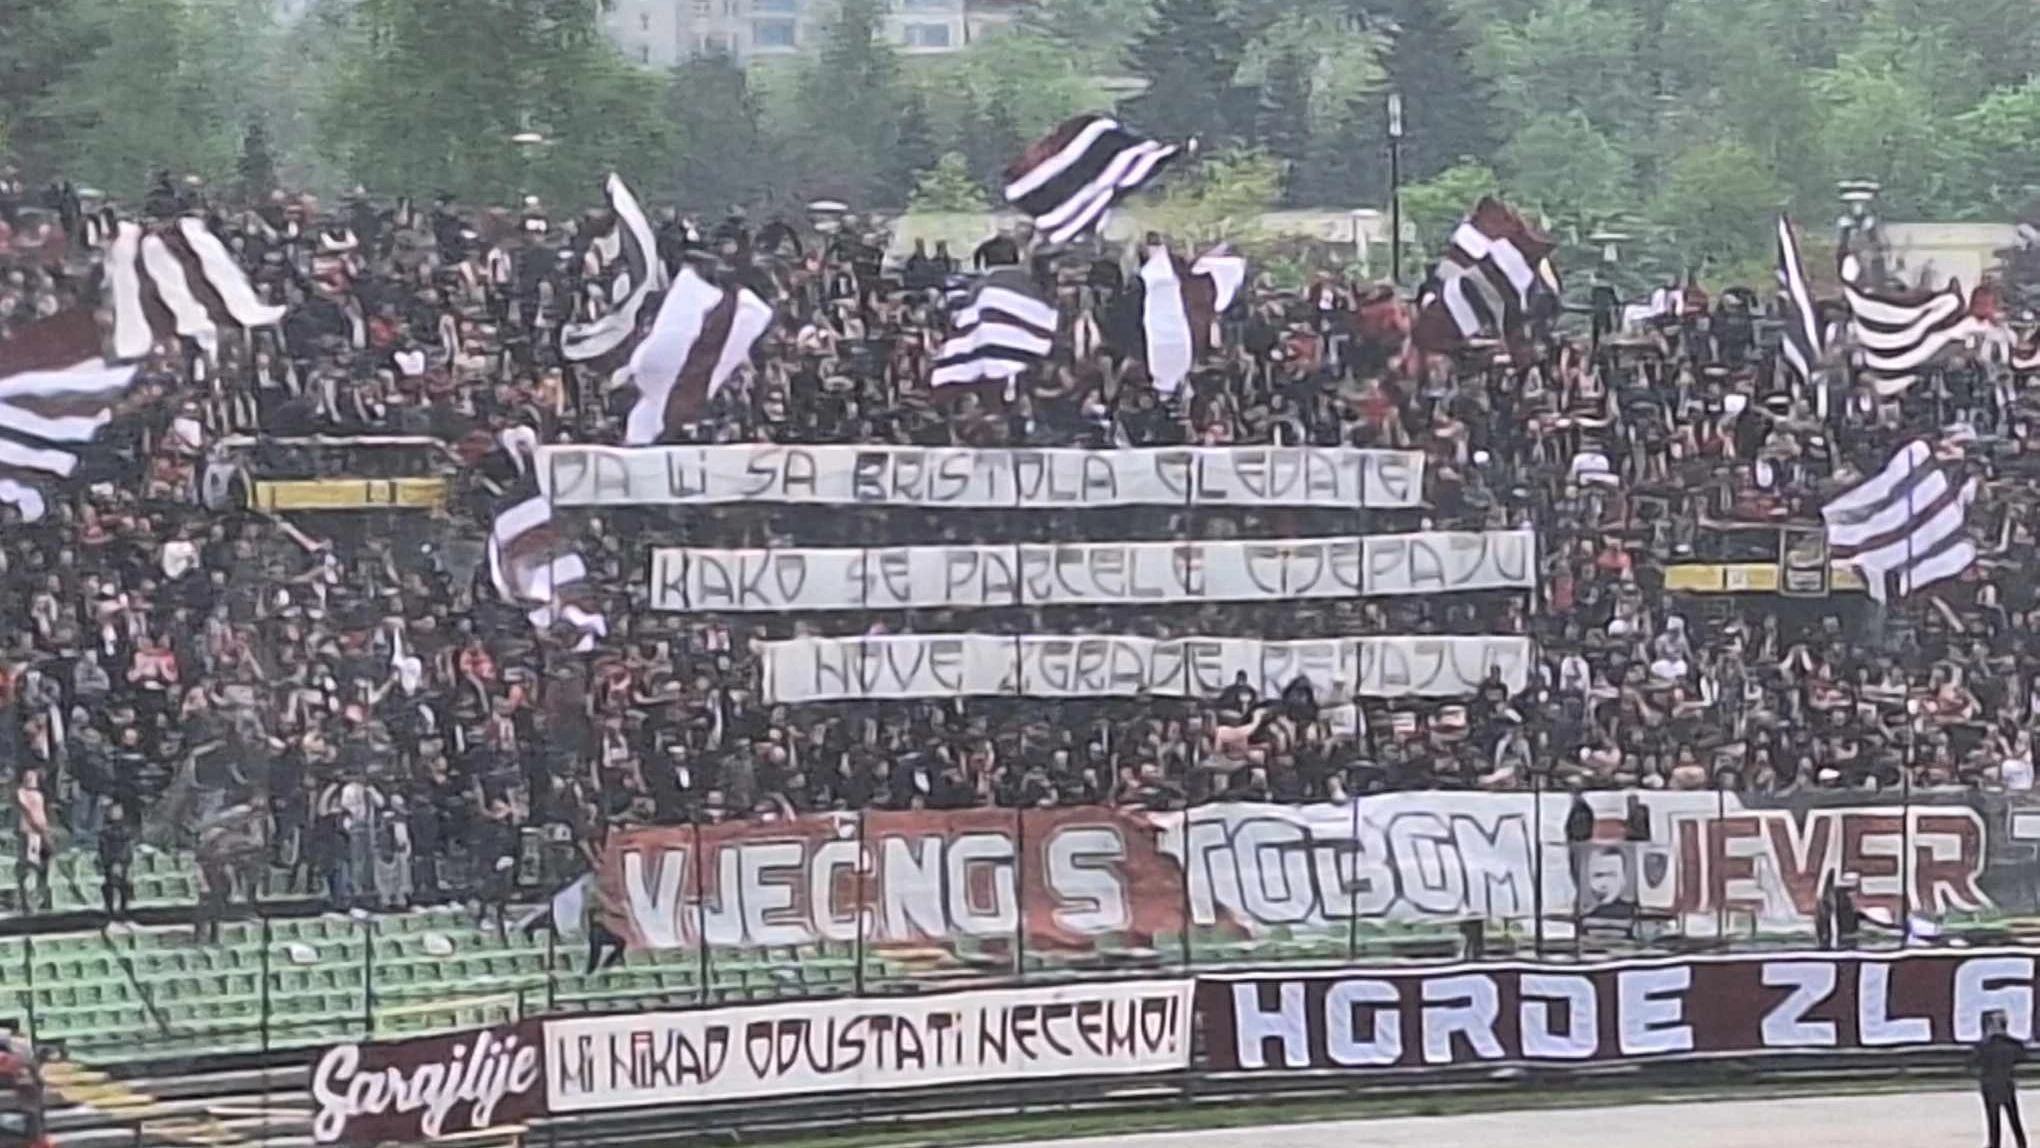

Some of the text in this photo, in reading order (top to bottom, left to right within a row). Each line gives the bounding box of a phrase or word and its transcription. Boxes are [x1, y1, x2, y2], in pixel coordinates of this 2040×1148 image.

[550, 451, 630, 499] DA
[746, 452, 816, 498] SA
[659, 549, 806, 606] KAKO
[846, 551, 909, 602] SE
[945, 547, 1205, 601] PARCELE
[814, 640, 964, 695] NOVE
[1045, 826, 1128, 932] S
[1178, 812, 1535, 925] TOBOM
[1231, 965, 1697, 1069] HORDE
[313, 1030, 538, 1143] Sarajlije
